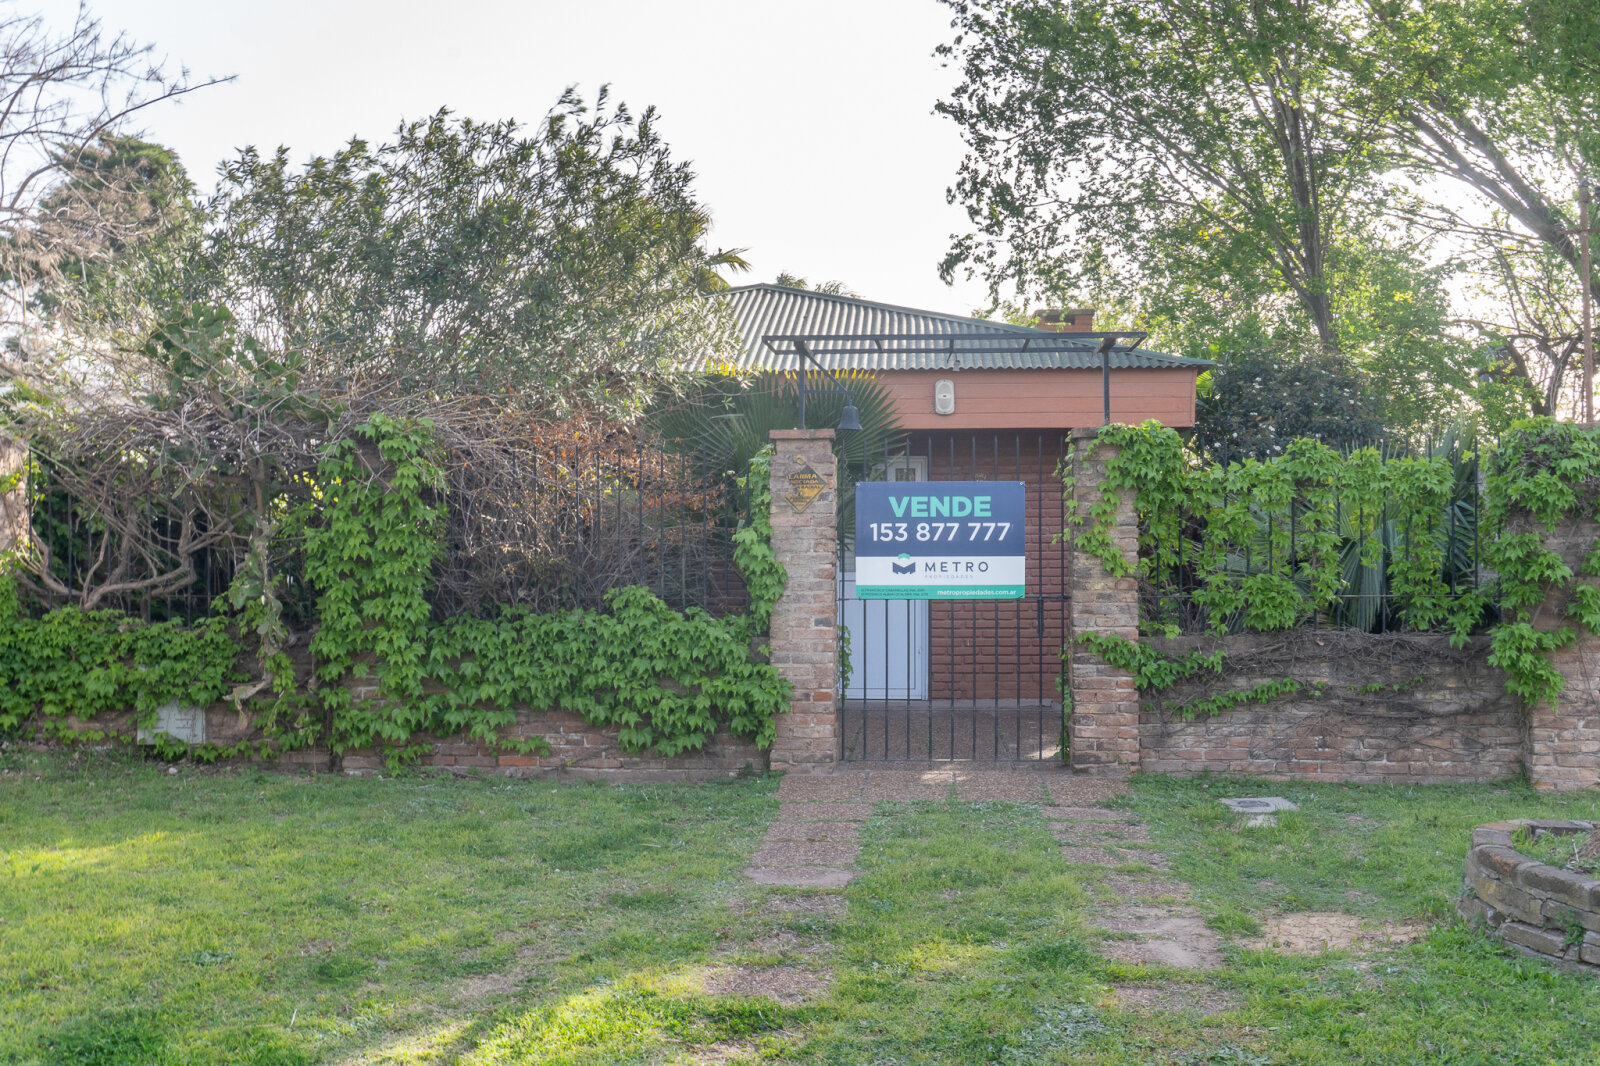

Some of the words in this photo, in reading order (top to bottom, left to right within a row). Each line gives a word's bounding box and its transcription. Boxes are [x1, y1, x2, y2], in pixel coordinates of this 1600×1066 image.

[888, 496, 992, 517] VENDE
[870, 522, 908, 542] 153
[916, 522, 960, 542] 877
[967, 522, 1011, 542] 777
[924, 561, 989, 573] METRO
